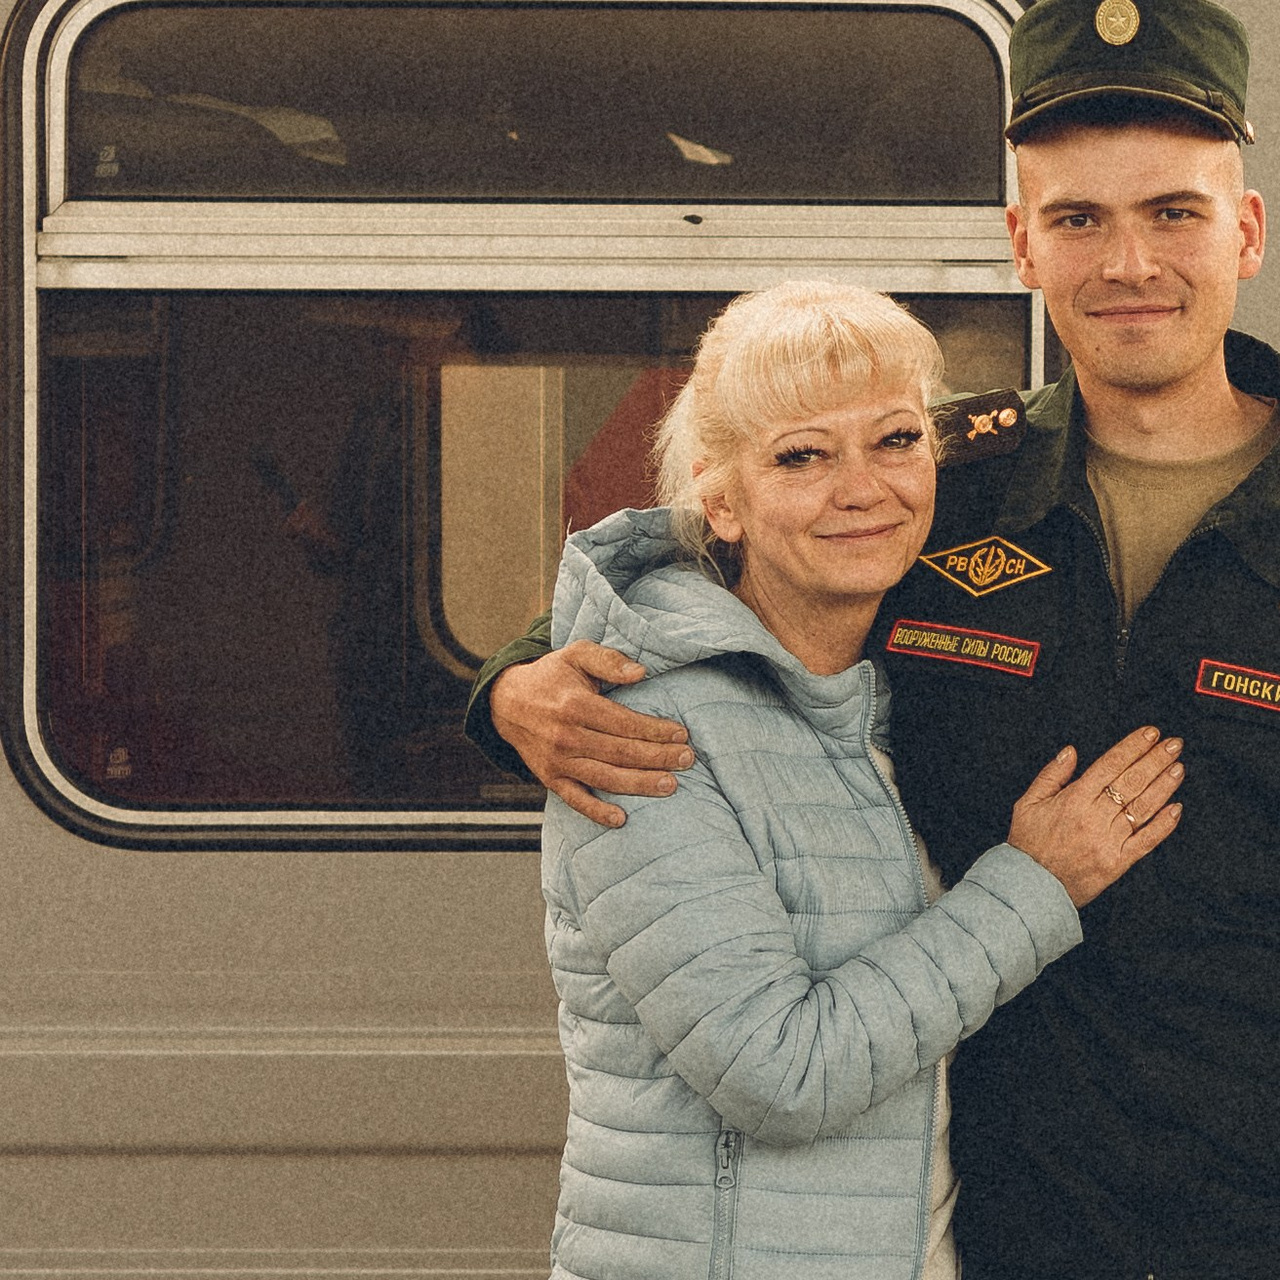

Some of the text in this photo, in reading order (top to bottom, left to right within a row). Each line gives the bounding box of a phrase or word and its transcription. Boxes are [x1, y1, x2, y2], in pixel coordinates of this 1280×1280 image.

[946, 555, 1026, 575] РВ СН
[893, 627, 1034, 667] ВООРУЖЕННЫЕ СИЛЫ РОССИИ
